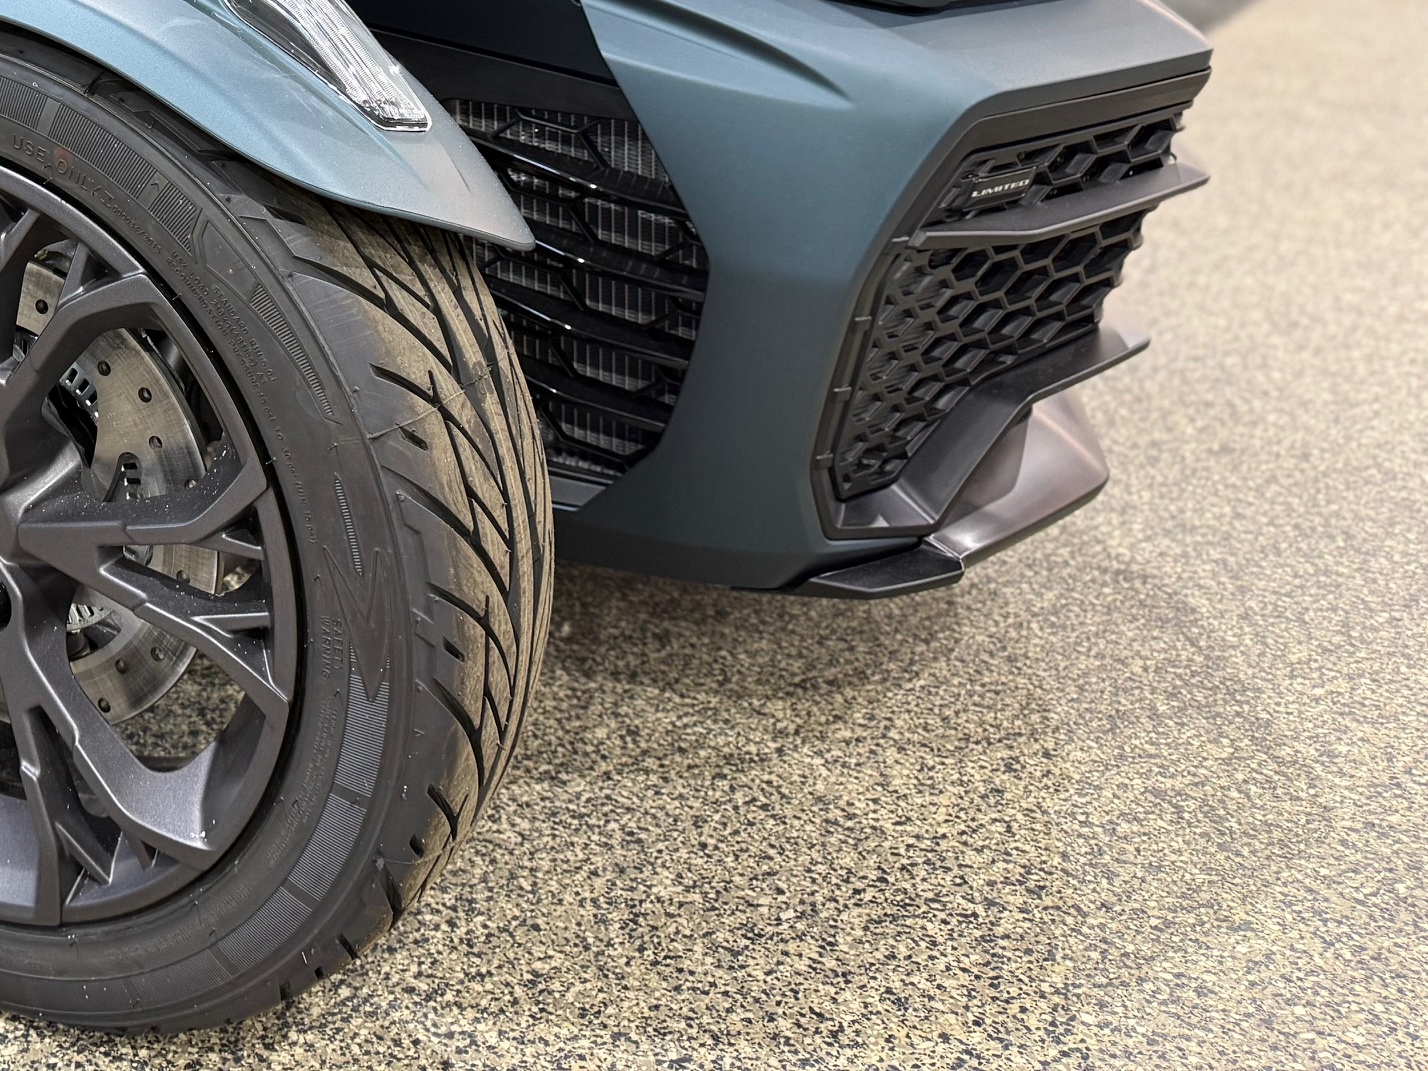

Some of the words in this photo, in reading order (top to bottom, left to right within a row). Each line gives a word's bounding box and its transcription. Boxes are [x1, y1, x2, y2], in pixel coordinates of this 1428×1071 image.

[13, 132, 49, 162] USE
[56, 158, 100, 198] ONLY
[971, 179, 1030, 198] LIMITED
